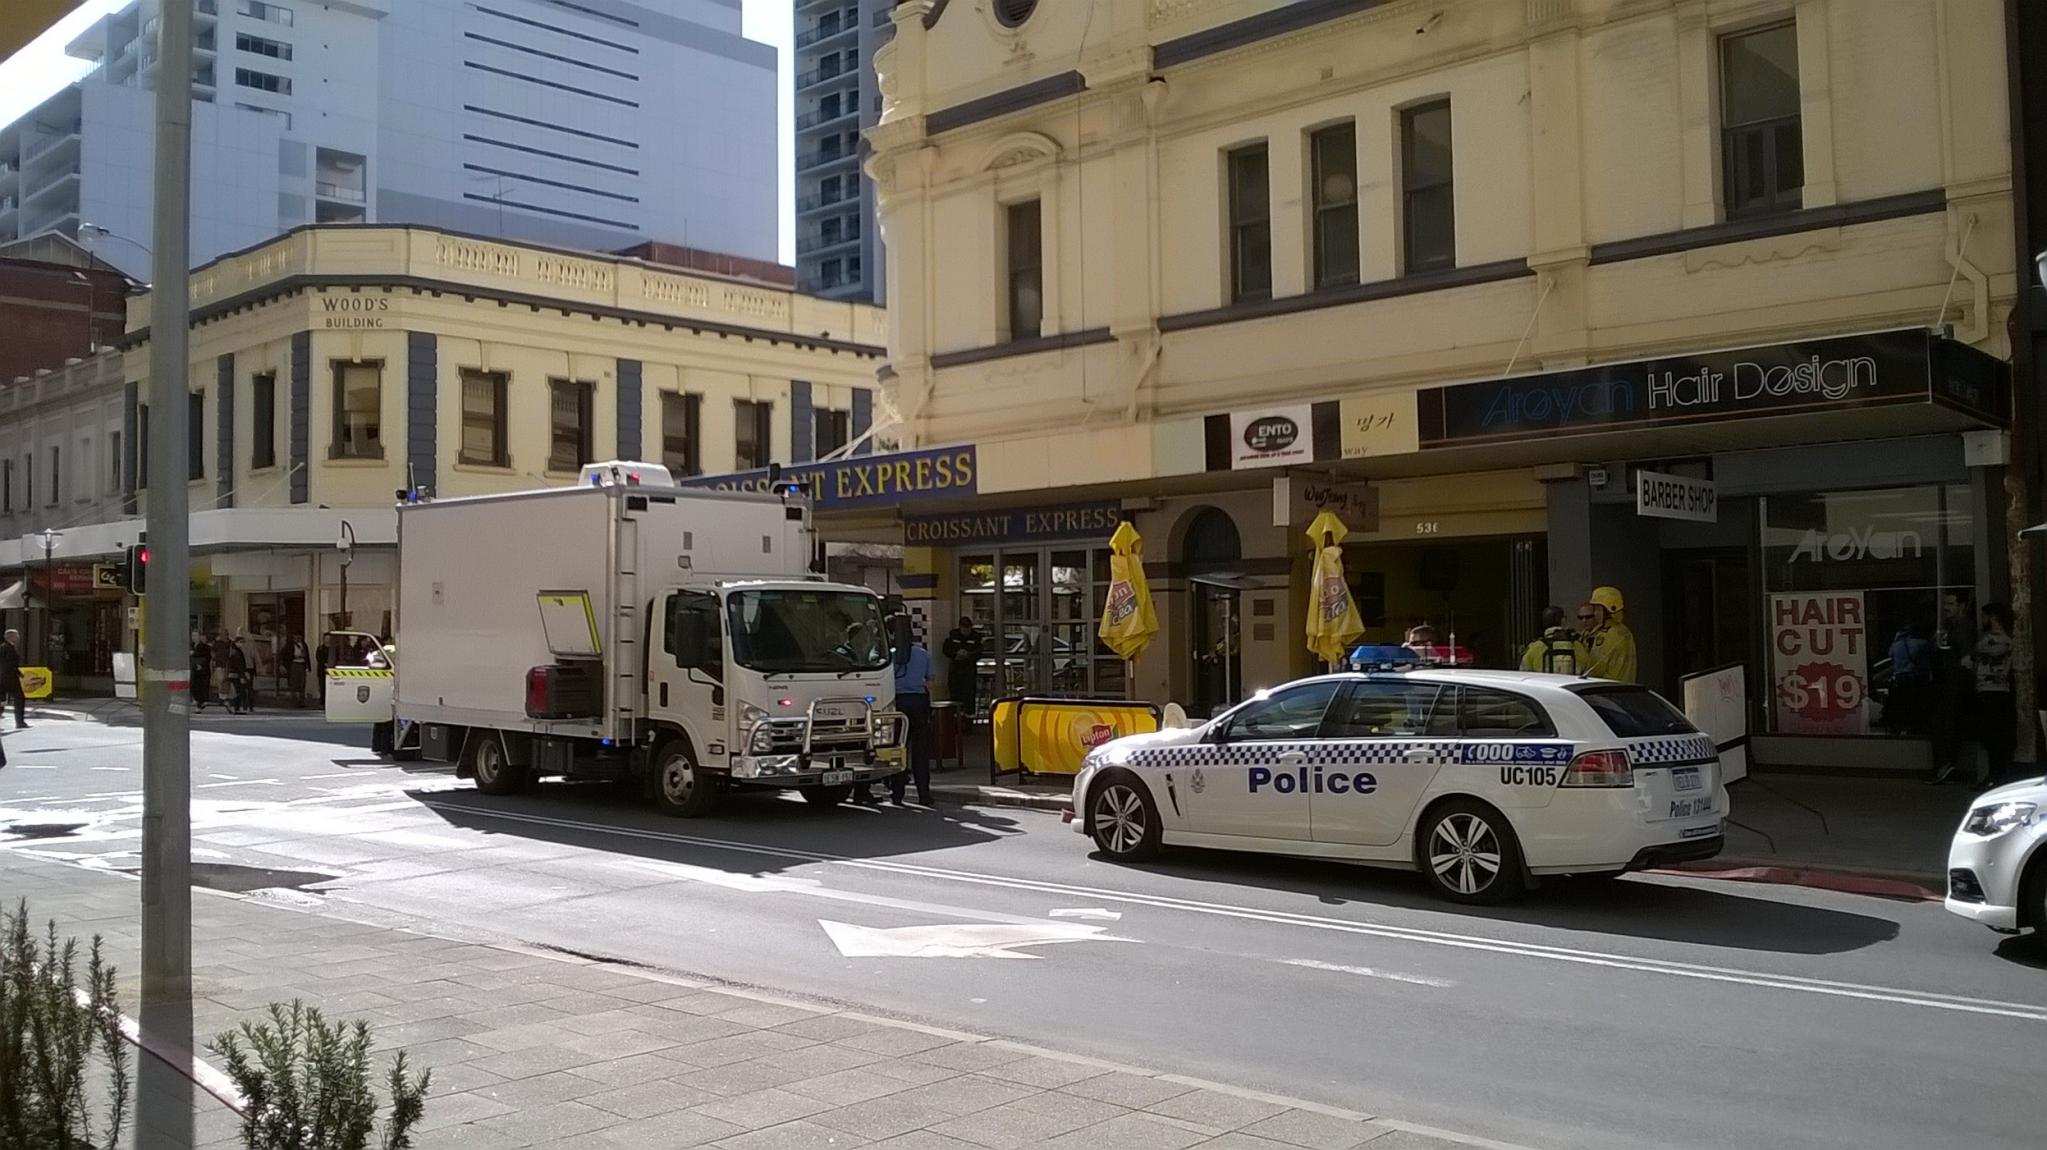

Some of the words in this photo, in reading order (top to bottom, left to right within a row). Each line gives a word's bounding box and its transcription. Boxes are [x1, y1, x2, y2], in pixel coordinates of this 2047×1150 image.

[322, 298, 389, 311] WOOD'S
[325, 317, 384, 328] BUILDING
[1647, 367, 1723, 409] Hair
[1734, 355, 1877, 400] Design
[836, 453, 973, 498] EXPRESS
[1642, 478, 1686, 511] BARBER
[1687, 485, 1715, 514] SHOP
[907, 515, 1012, 541] CROISSANT
[1025, 508, 1119, 534] EXPRESS
[1775, 597, 1861, 626] HAIR
[1776, 627, 1863, 656] CUT
[1781, 669, 1861, 713] $19
[1476, 744, 1515, 761] 000
[1248, 766, 1378, 795] Police
[1500, 766, 1557, 786] UC105
